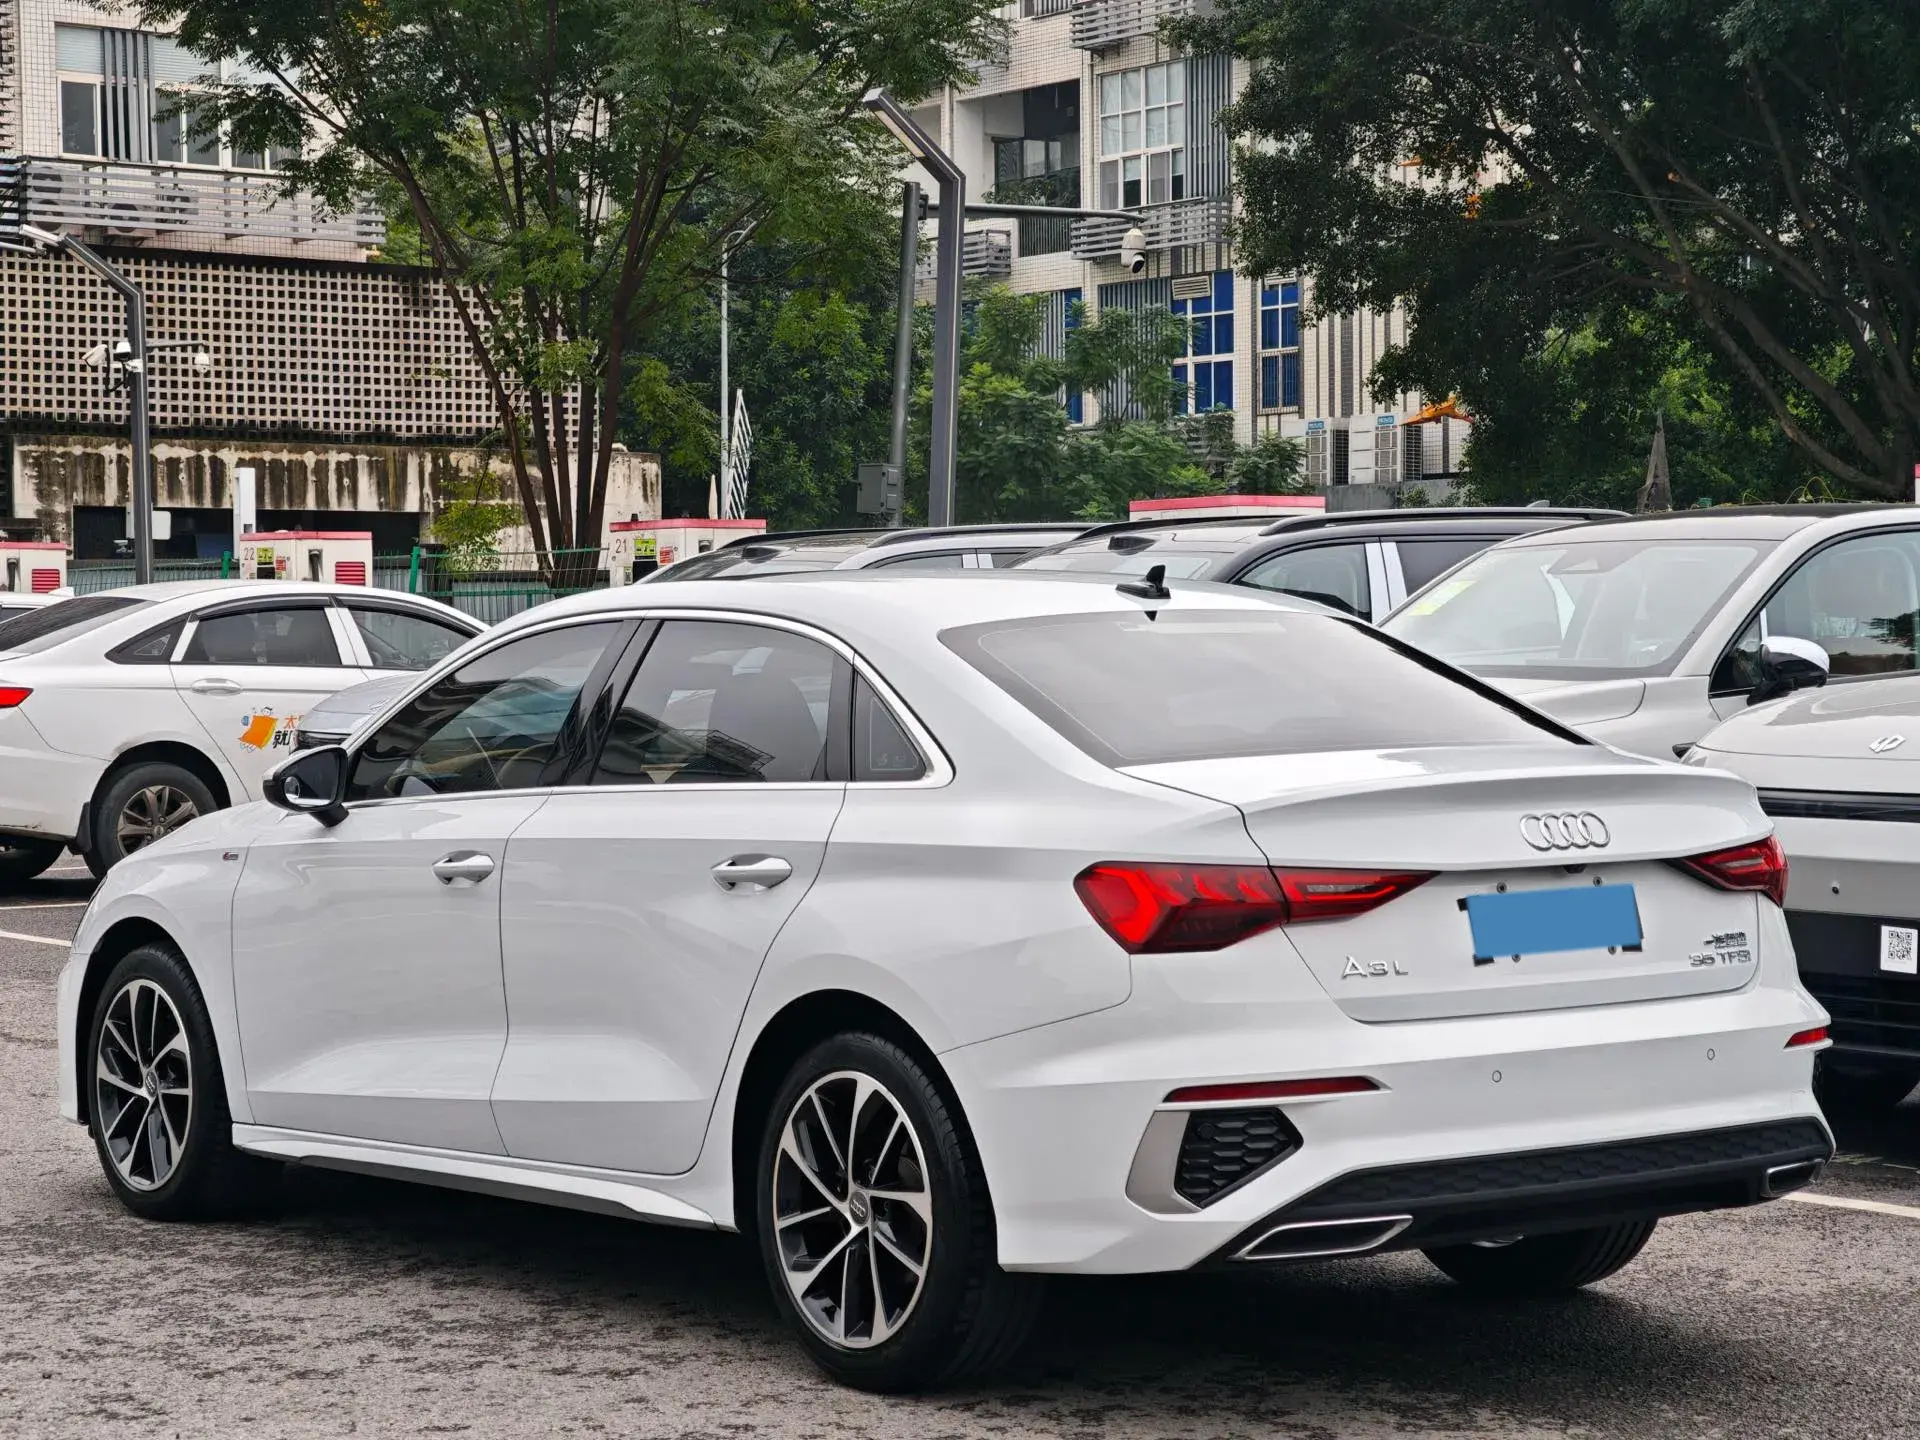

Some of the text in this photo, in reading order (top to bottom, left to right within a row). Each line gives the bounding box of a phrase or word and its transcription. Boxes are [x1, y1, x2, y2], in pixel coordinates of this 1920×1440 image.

[244, 546, 255, 561] 22
[615, 538, 627, 554] 21
[272, 729, 293, 749] 就
[1688, 949, 1752, 967] 35 TFSI
